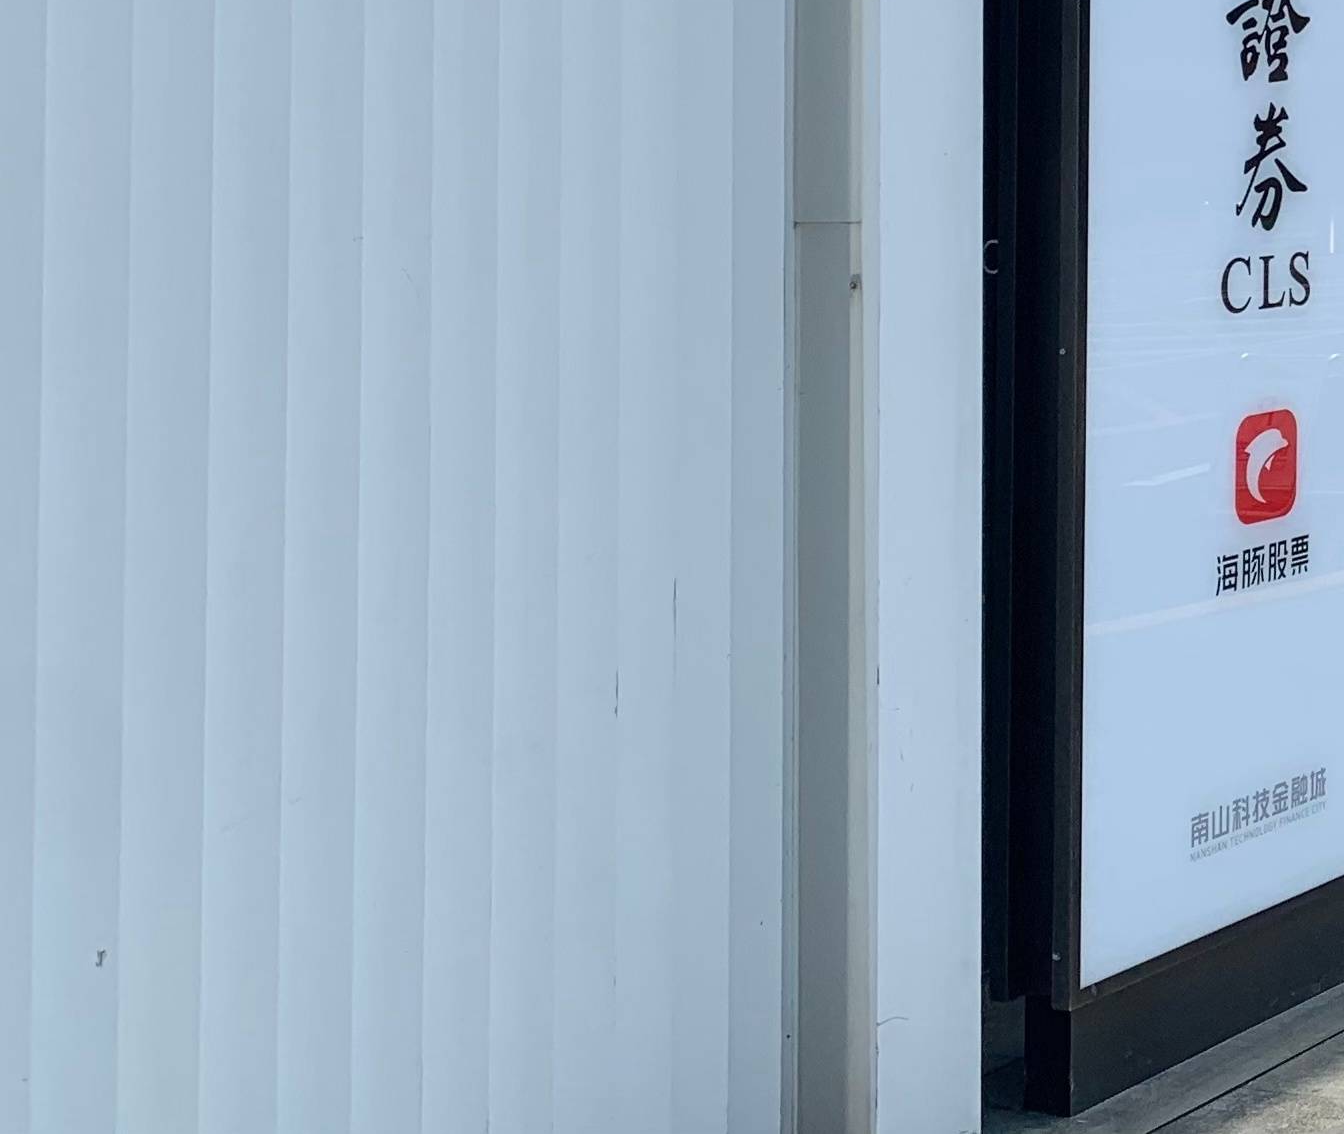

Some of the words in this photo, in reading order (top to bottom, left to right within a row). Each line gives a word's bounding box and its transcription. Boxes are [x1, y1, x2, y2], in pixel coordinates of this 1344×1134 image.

[1221, 250, 1311, 314] CLS
[1216, 534, 1310, 596] 海豚股票
[1189, 840, 1228, 863] NANSHAN
[1229, 822, 1278, 848] TECHNOLOGY
[1279, 806, 1310, 829] FINANCE
[1311, 800, 1327, 814] CITY
[1191, 767, 1327, 848] 南山科技金融城
